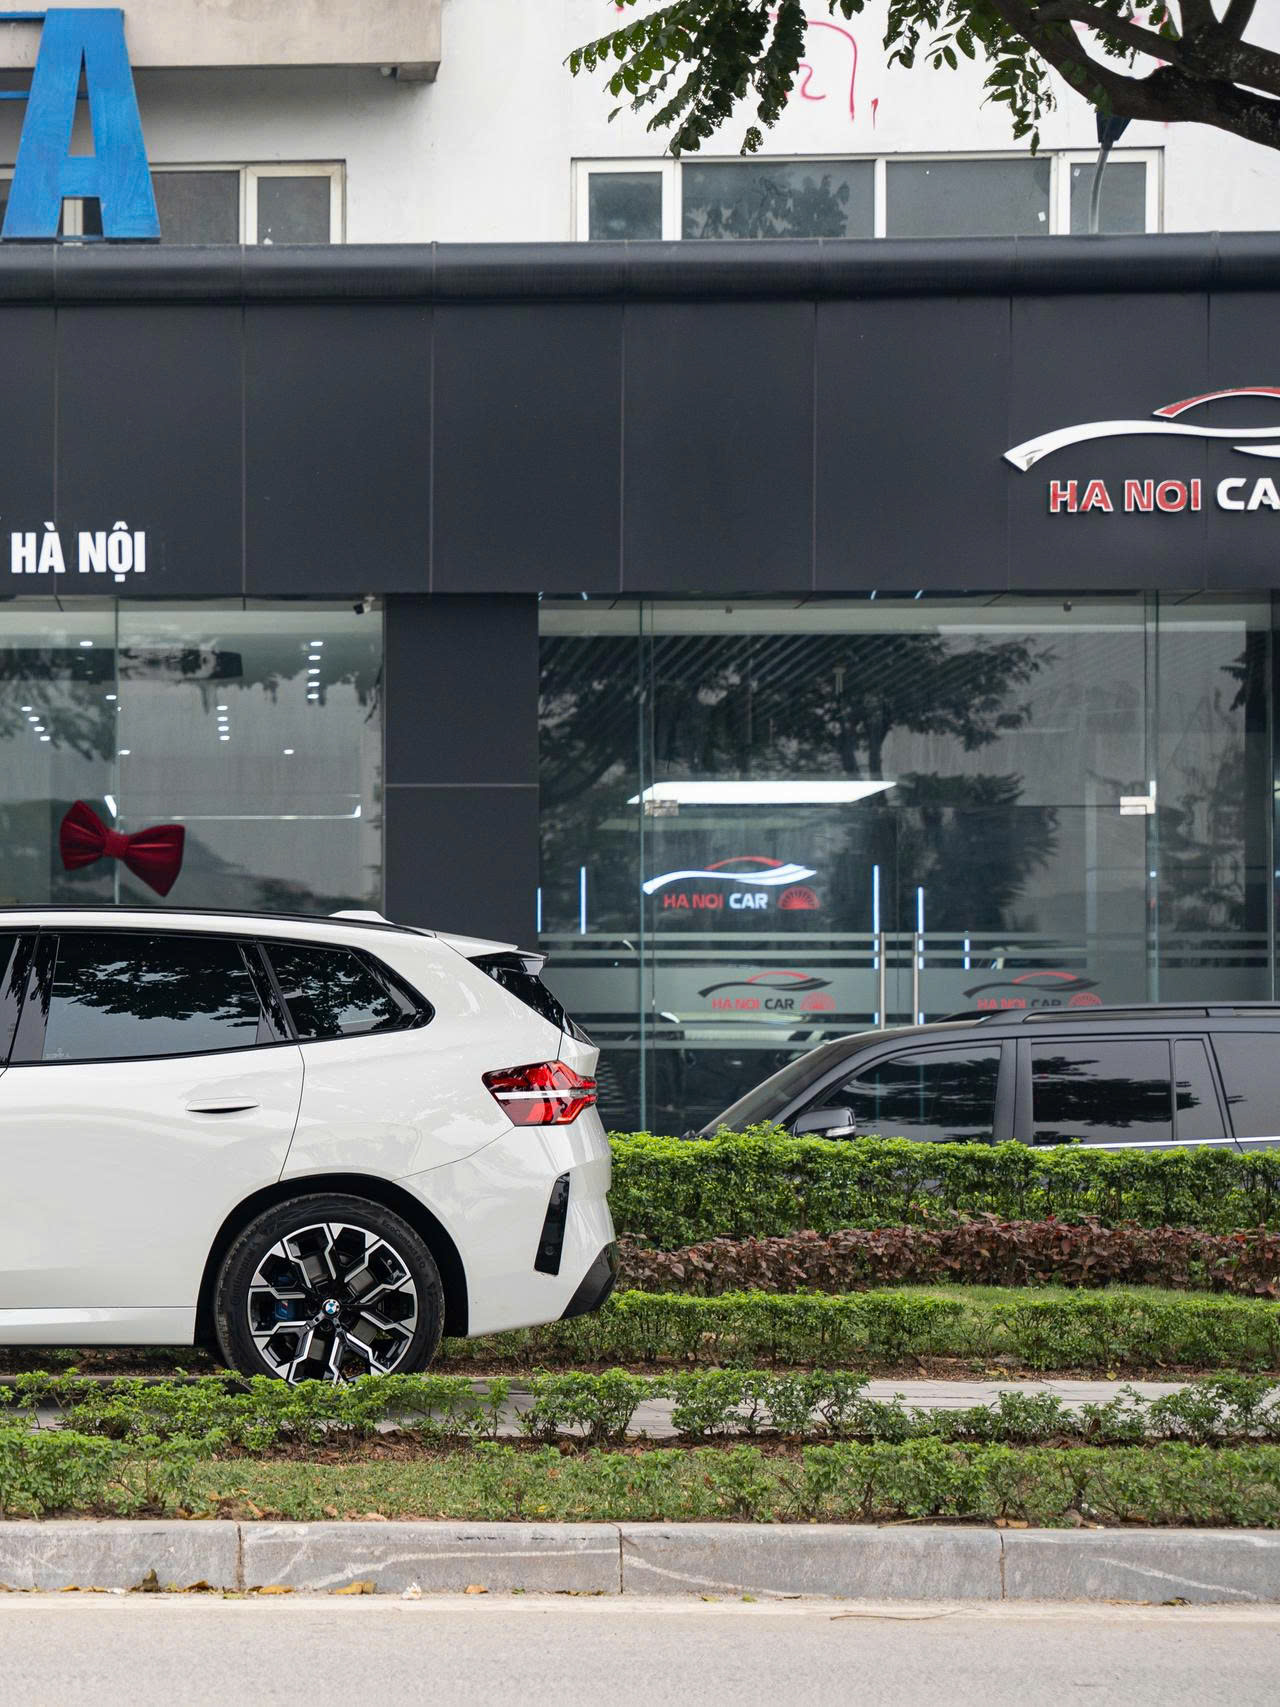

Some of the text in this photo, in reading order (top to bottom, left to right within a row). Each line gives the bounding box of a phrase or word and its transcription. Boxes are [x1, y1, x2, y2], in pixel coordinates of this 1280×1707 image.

[1049, 478, 1114, 513] HA
[1123, 478, 1202, 512] NOI
[11, 521, 66, 574] HÀ
[78, 520, 146, 583] NỘI
[662, 892, 768, 910] HA NOI CAR
[711, 997, 794, 1010] HA NOI CAR
